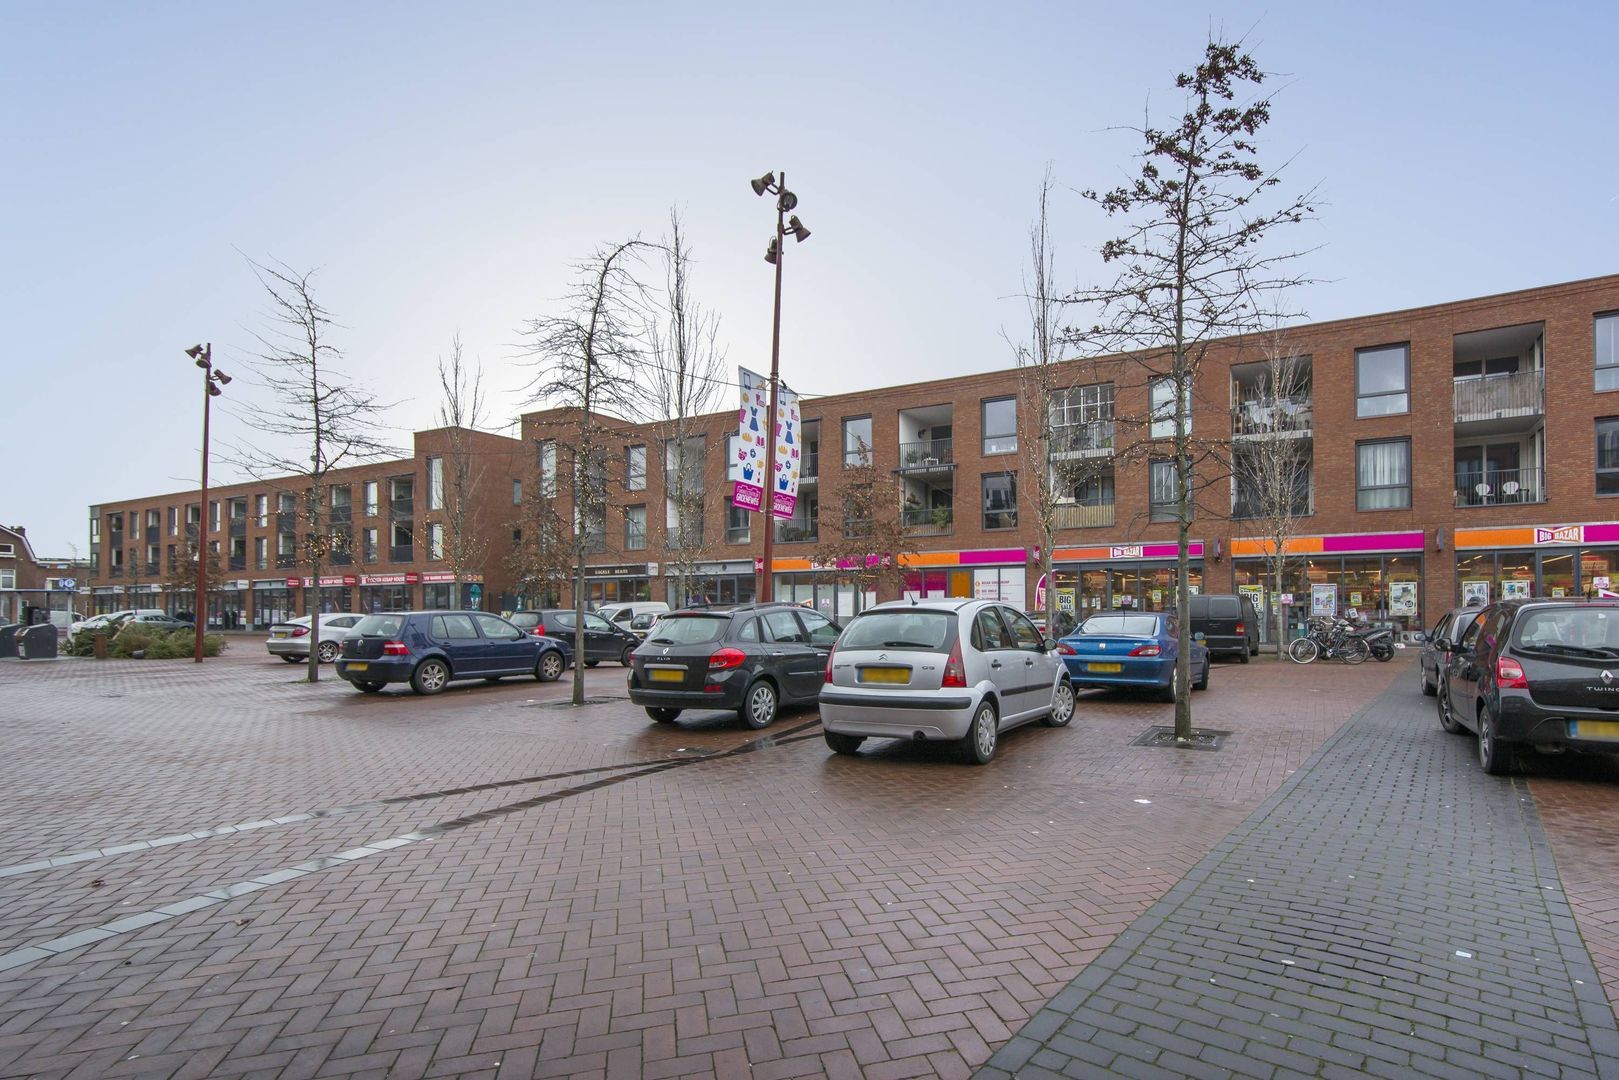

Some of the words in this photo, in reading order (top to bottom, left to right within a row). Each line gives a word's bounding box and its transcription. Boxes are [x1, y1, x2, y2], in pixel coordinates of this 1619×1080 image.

[1539, 530, 1552, 542] BIG
[1554, 527, 1579, 541] BAZAR
[1059, 595, 1072, 604] BIG
